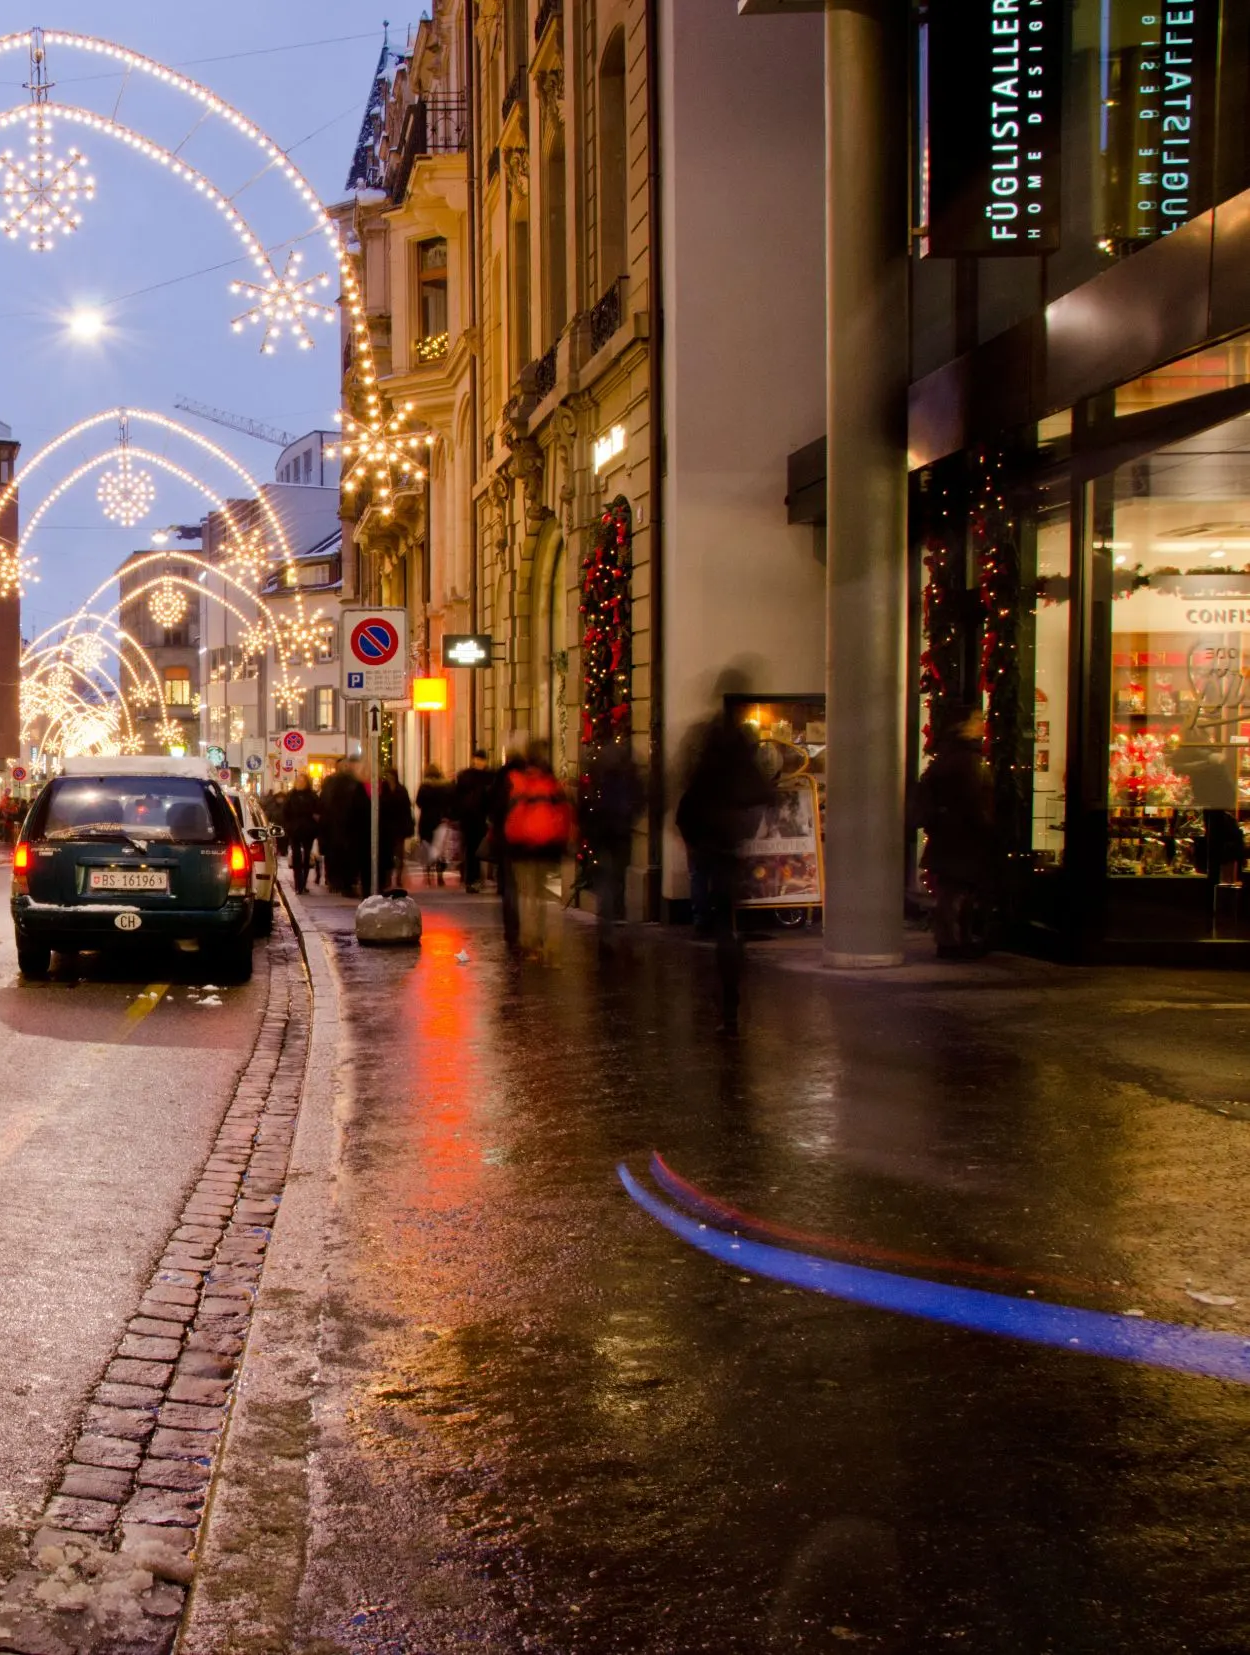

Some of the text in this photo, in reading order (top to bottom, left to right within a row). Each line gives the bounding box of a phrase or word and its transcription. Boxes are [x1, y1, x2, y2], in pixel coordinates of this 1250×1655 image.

[986, 0, 1019, 239] FÜGLISTALLER
[1028, 152, 1042, 238] HOME
[351, 674, 361, 687] P
[123, 874, 156, 887] 16196
[120, 915, 136, 928] CH
